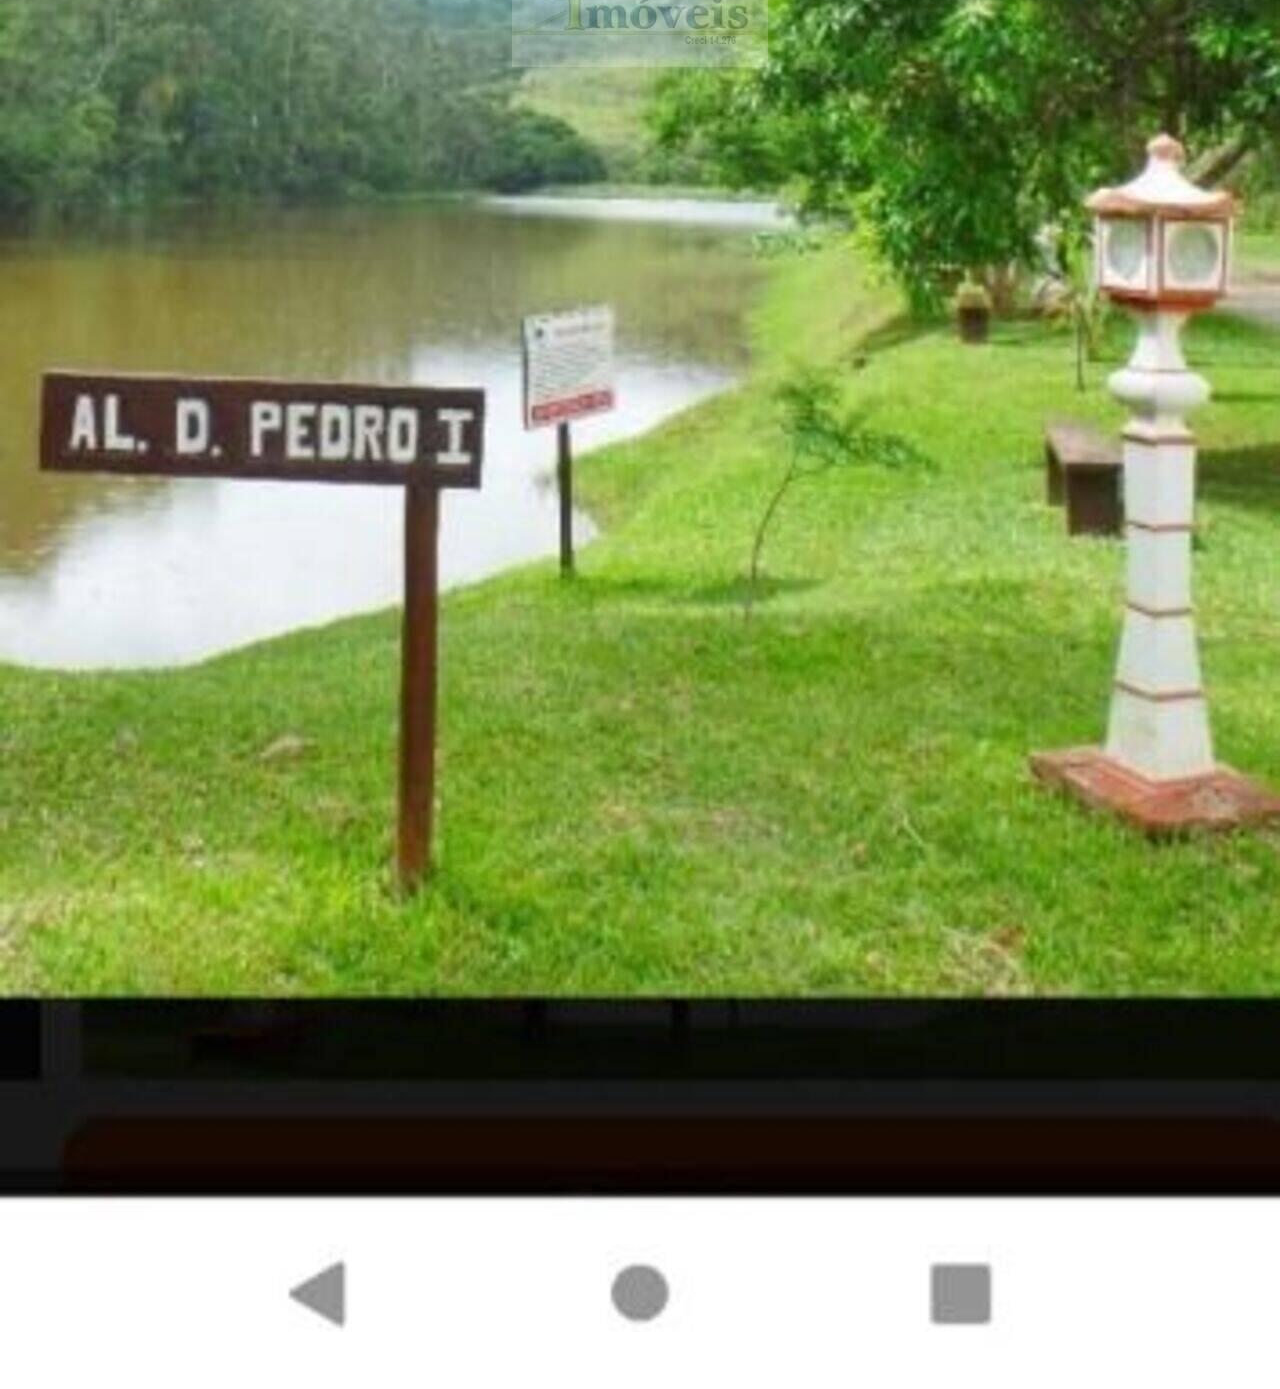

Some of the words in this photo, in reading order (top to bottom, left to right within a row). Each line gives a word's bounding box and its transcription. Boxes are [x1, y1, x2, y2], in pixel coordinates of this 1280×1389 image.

[69, 393, 148, 452] AL.
[175, 398, 222, 457] D.
[250, 400, 419, 464] PEDRO
[435, 408, 474, 465] I
